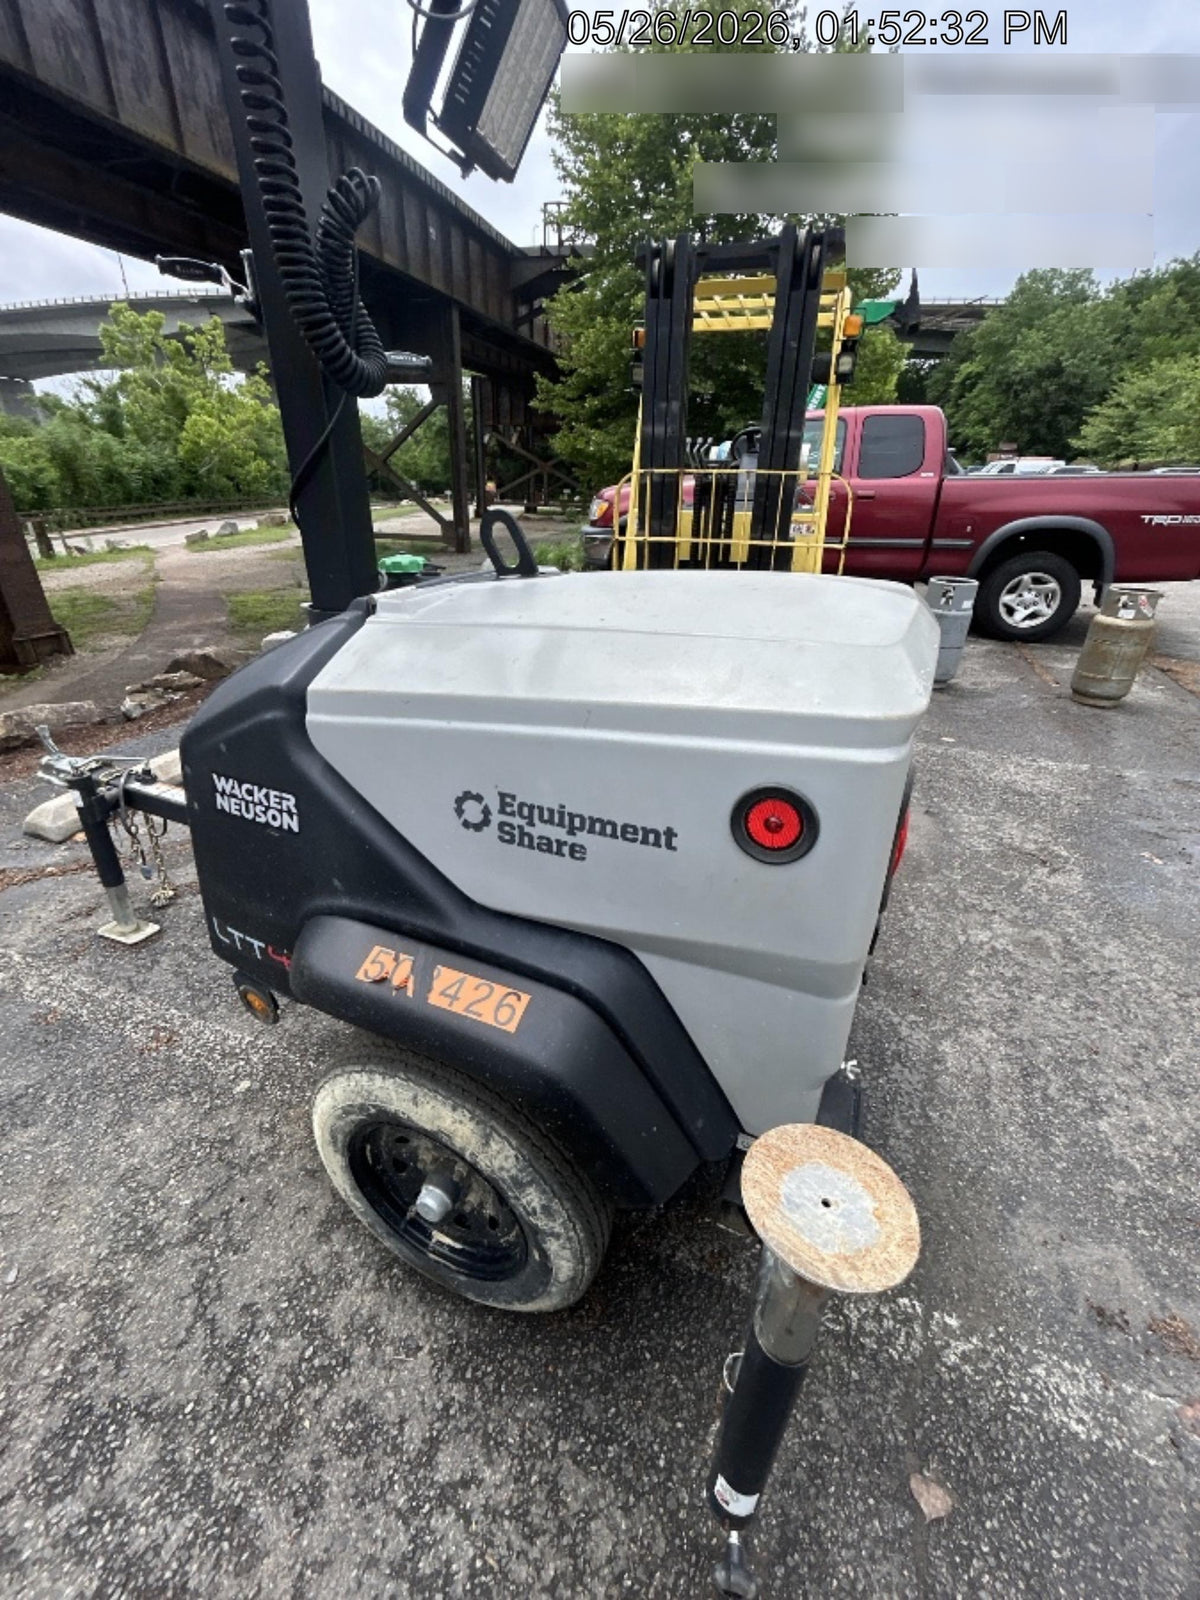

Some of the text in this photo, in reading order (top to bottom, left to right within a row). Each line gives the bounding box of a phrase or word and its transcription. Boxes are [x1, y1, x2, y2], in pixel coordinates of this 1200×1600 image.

[212, 772, 298, 814] WACKER
[214, 792, 300, 833] NEUSON
[497, 791, 678, 852] Equipment
[497, 820, 588, 862] Share
